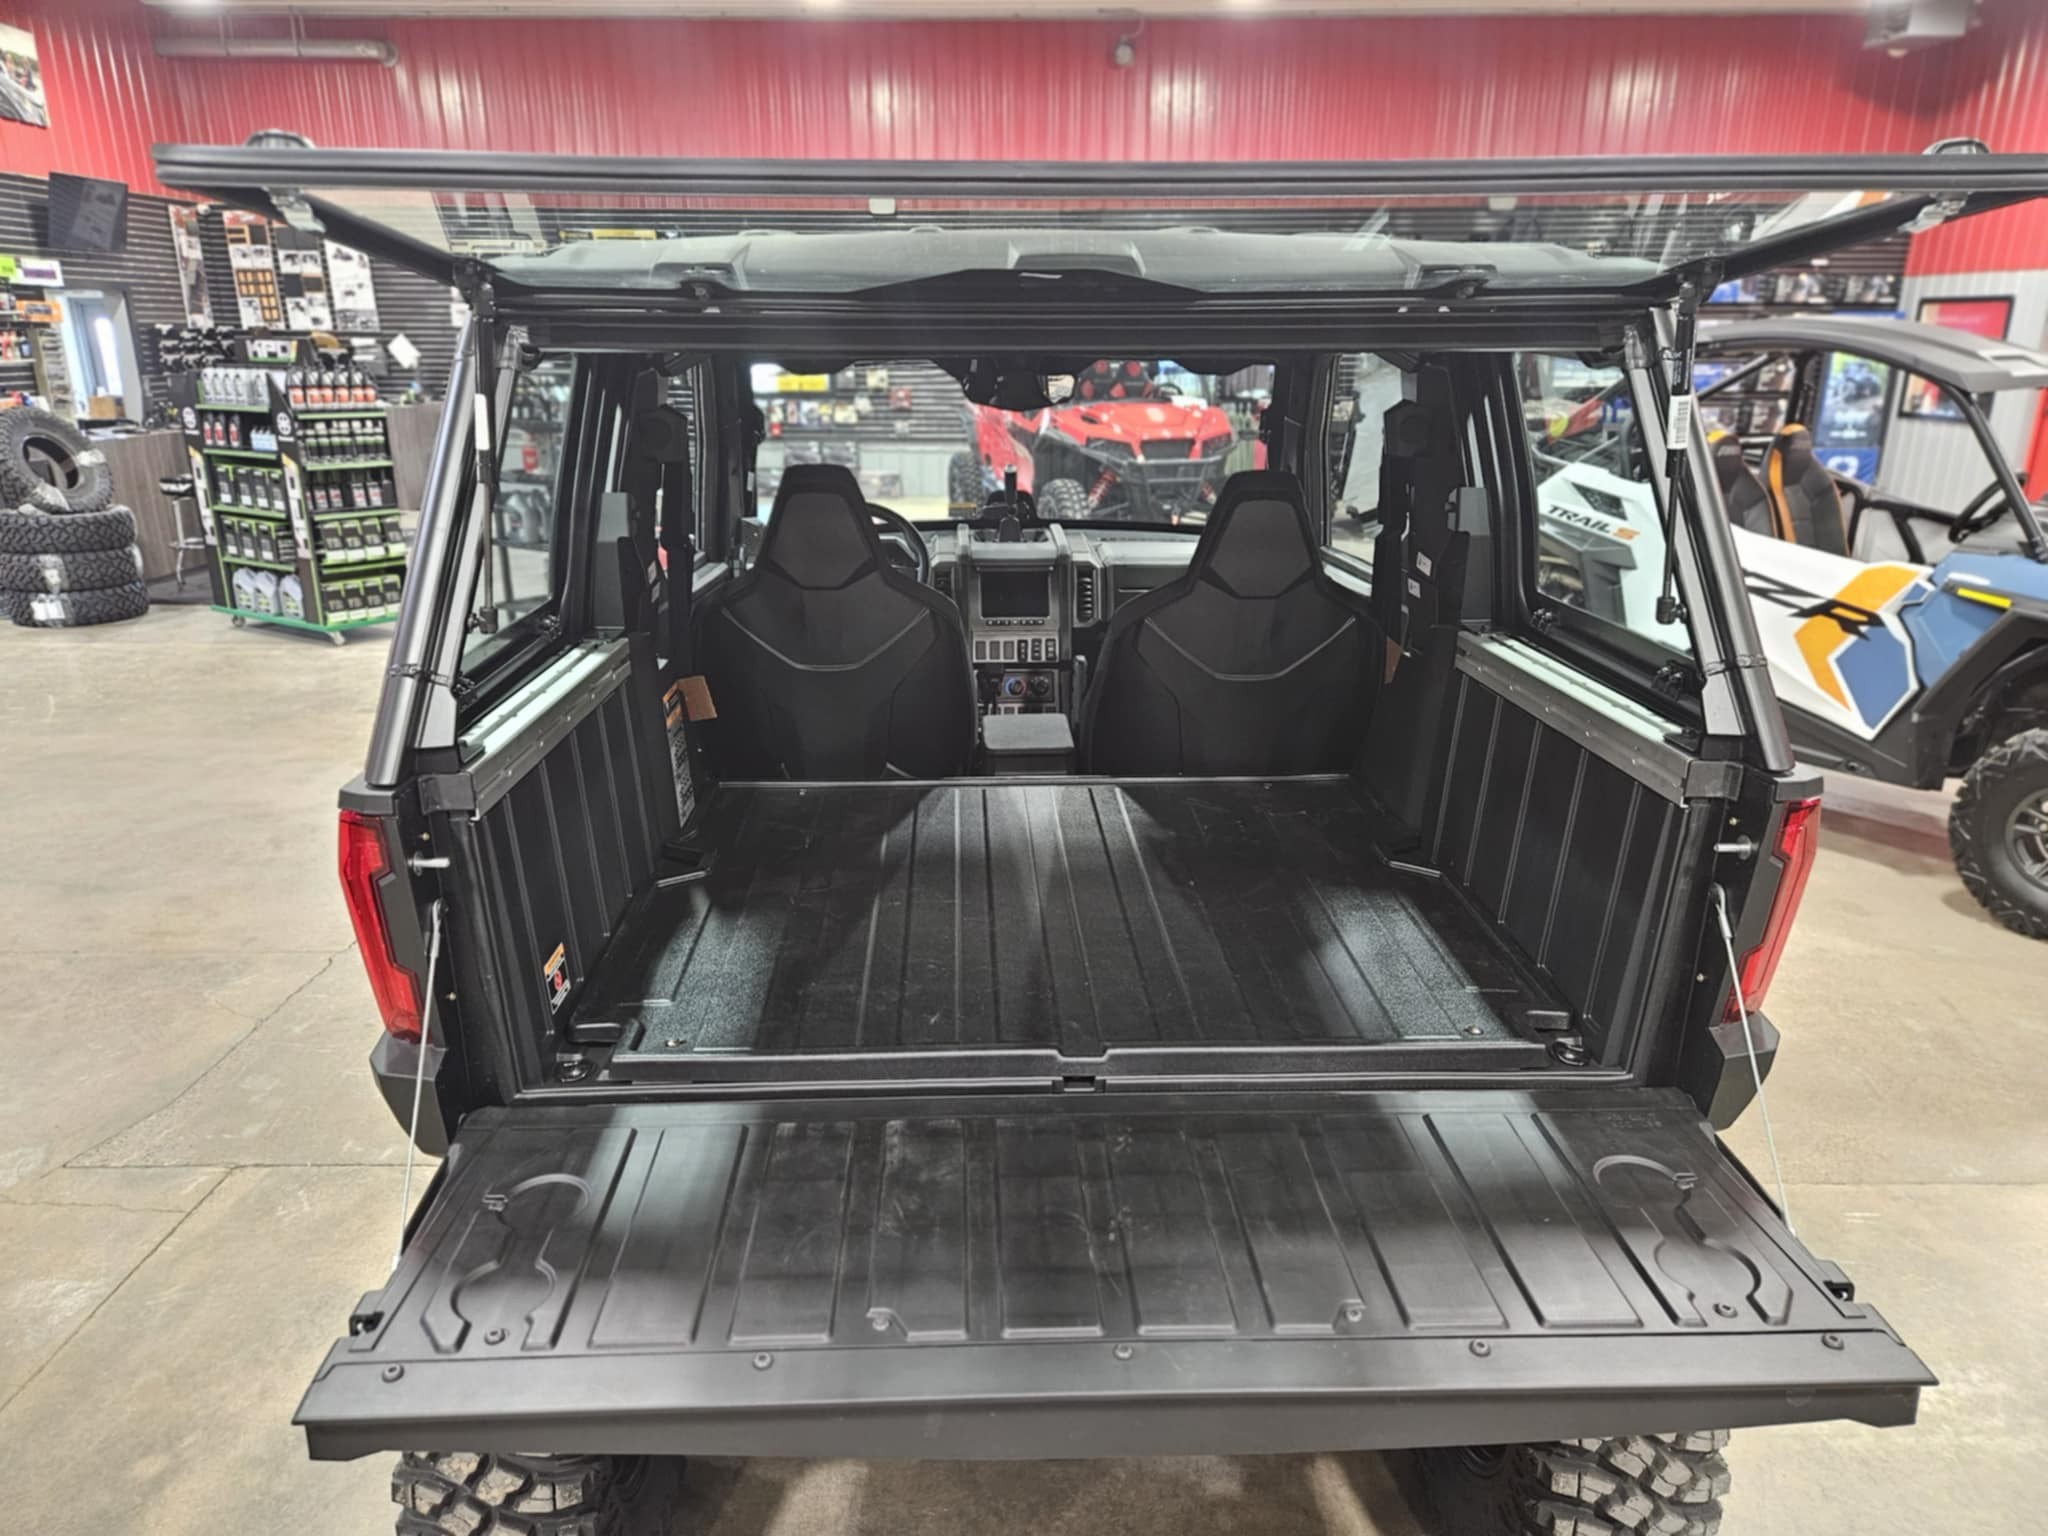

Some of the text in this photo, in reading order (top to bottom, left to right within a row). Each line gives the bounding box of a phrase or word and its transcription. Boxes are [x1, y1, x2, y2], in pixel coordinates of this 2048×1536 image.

[1548, 504, 1640, 541] TRAIL S
[1742, 568, 1886, 641] ZR
